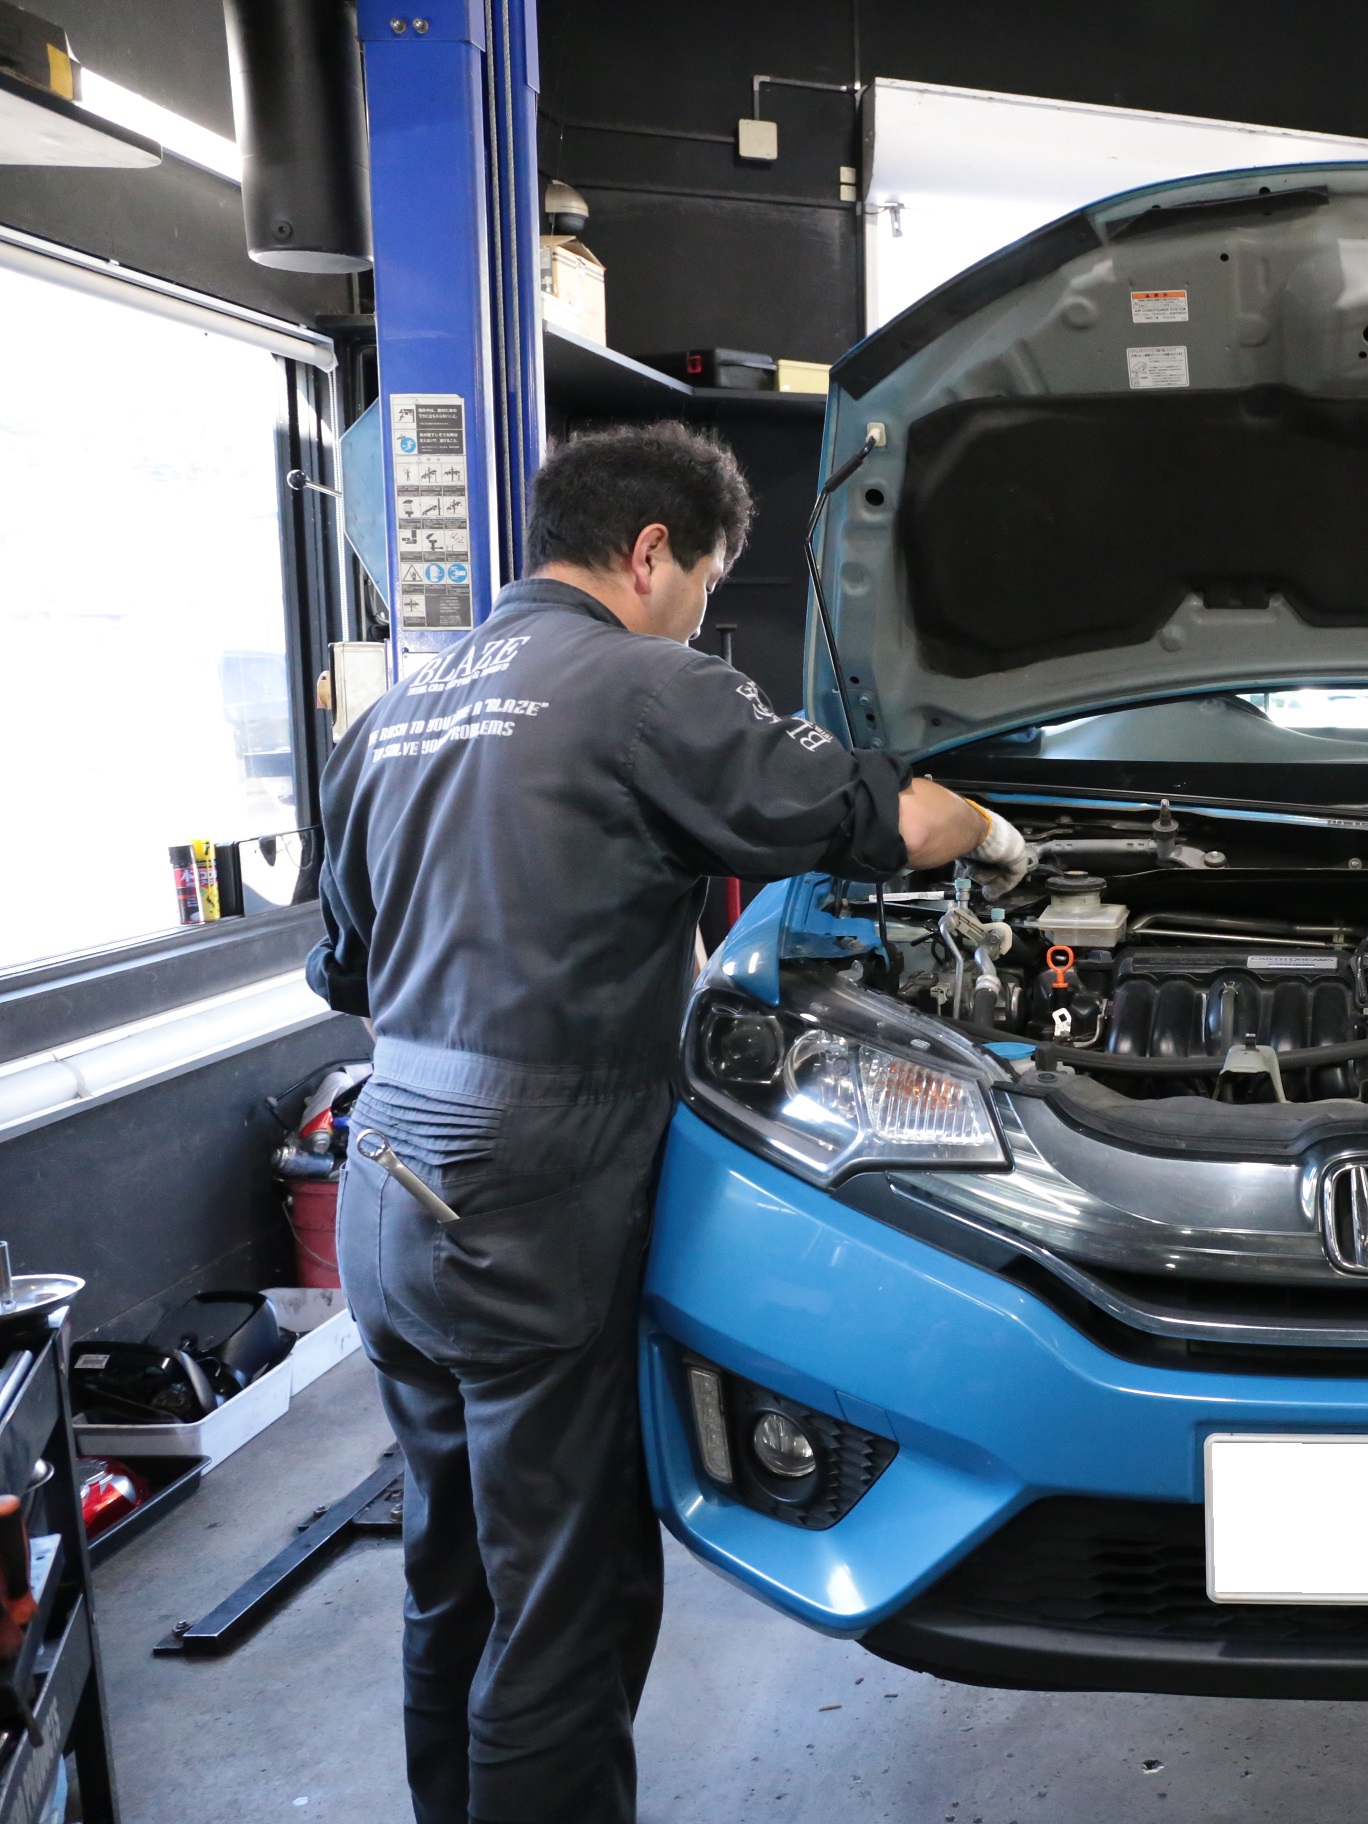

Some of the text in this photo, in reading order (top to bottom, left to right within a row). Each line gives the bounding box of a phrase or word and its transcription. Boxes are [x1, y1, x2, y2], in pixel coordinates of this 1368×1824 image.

[409, 636, 531, 687] BLAZE
[428, 682, 445, 692] CAR
[380, 722, 407, 740] RUSH
[409, 720, 426, 735] TO
[426, 716, 452, 732] YOU
[472, 701, 483, 716] A
